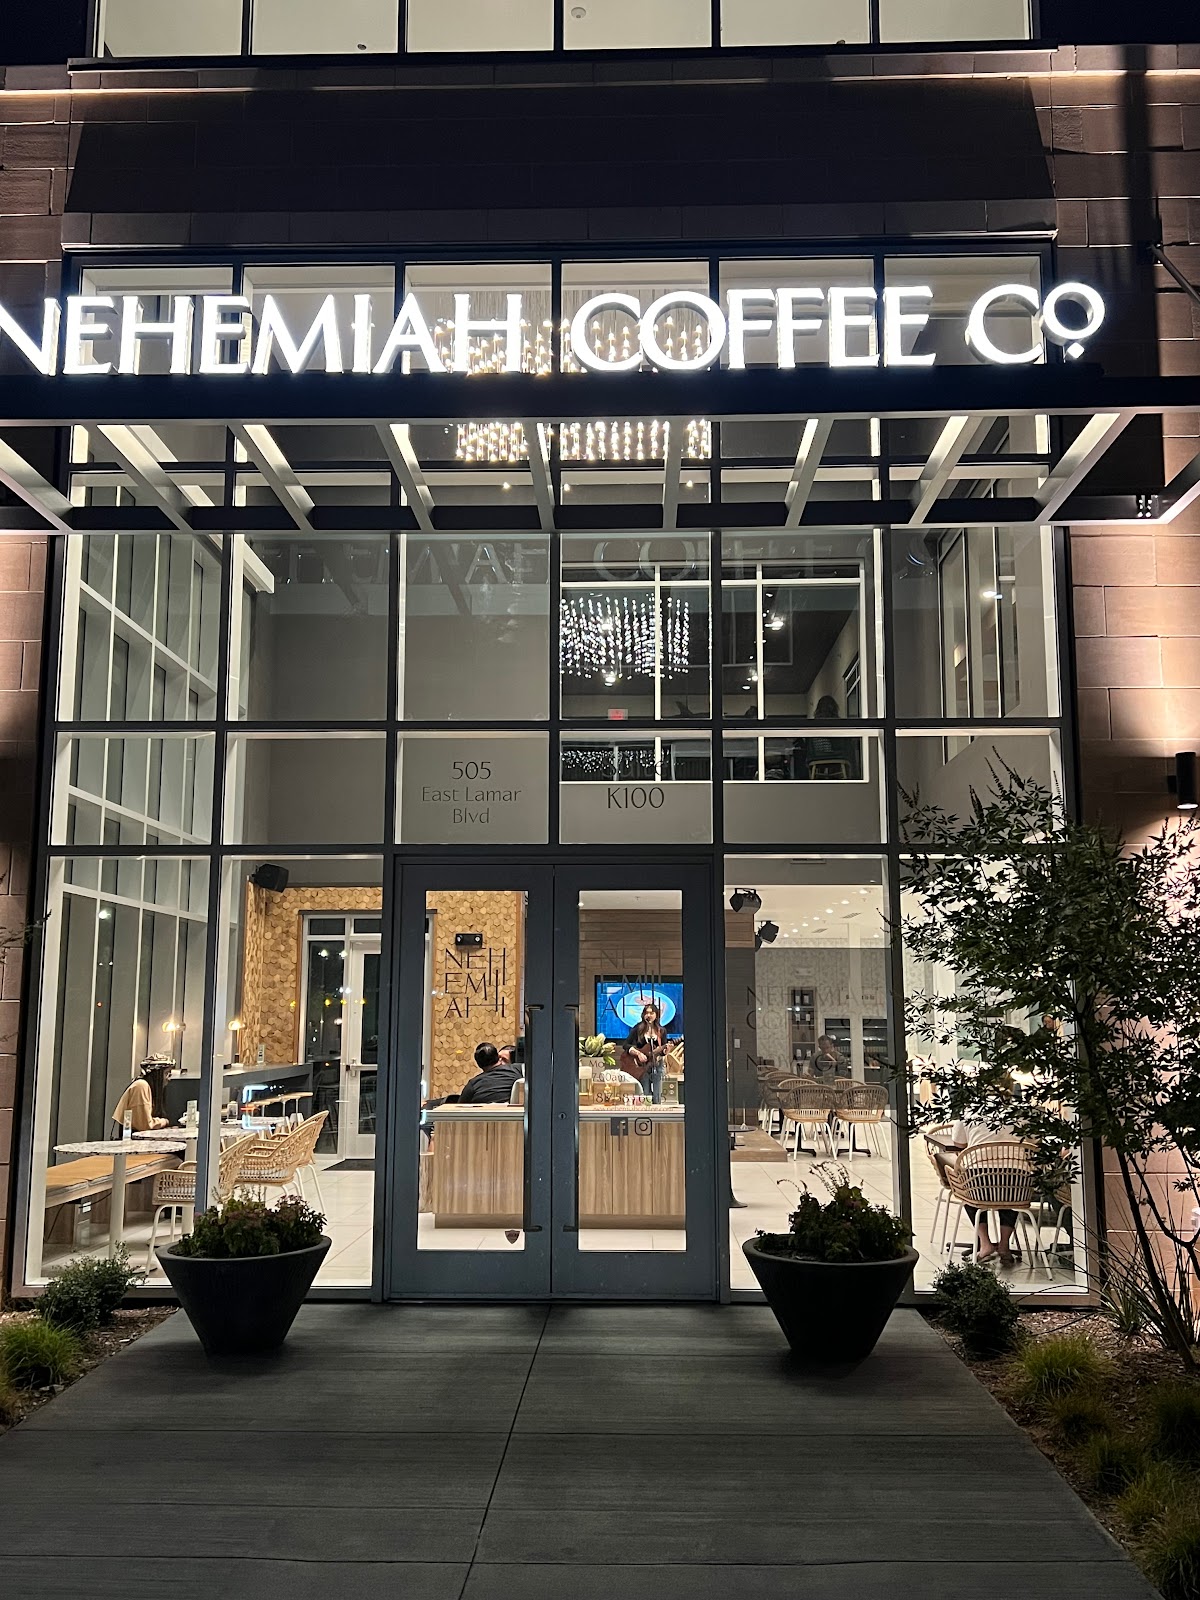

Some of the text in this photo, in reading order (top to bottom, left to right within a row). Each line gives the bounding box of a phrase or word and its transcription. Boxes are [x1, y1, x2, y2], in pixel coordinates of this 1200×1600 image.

[0, 294, 523, 375] NEHEMIAH
[570, 285, 936, 371] COFFEE
[451, 761, 492, 780] 505
[421, 786, 522, 802] East Lamar
[607, 787, 666, 809] K100
[452, 808, 490, 824] Blvd
